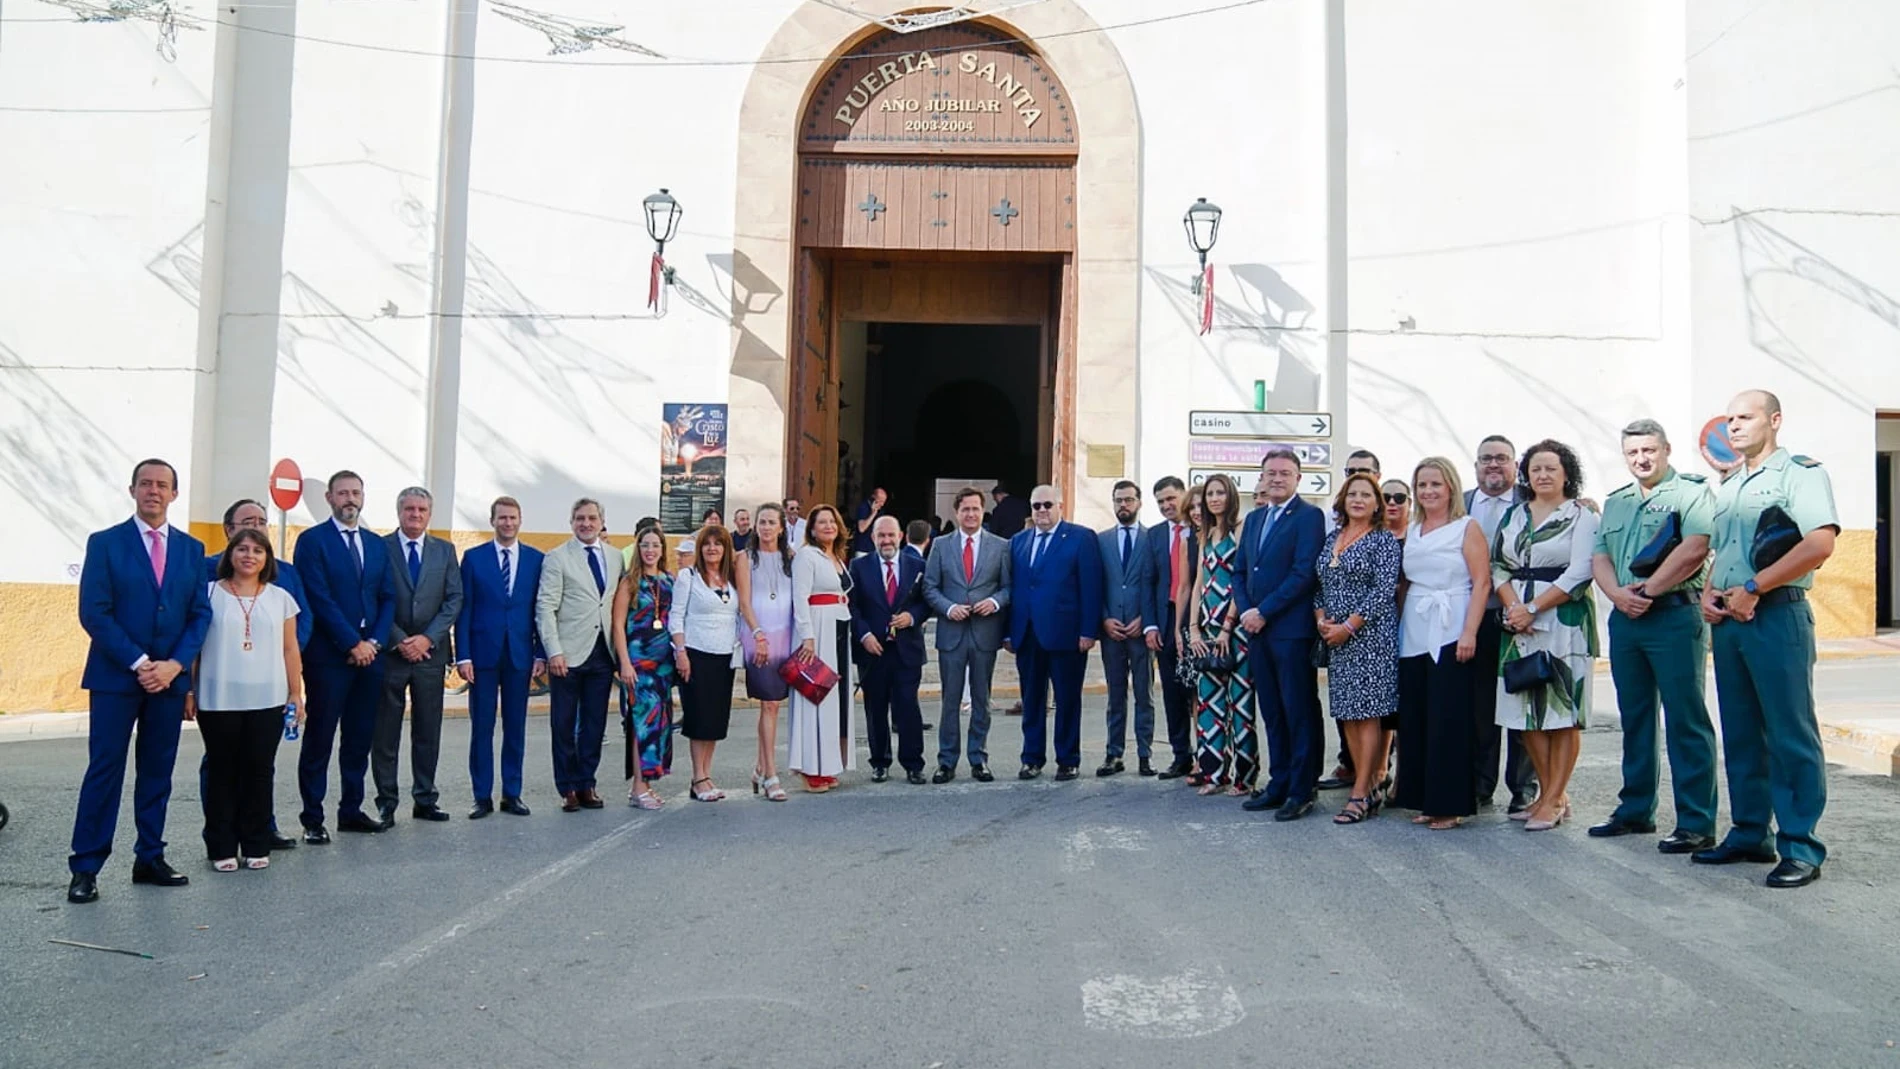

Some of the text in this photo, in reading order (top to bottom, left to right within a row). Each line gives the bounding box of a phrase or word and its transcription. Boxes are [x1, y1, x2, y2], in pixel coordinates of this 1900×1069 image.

[834, 51, 1043, 128] PUERTA SANTA
[879, 96, 1001, 113] AÑO JUBILAR
[904, 120, 975, 132] 2003-2004
[1193, 418, 1231, 427] casino
